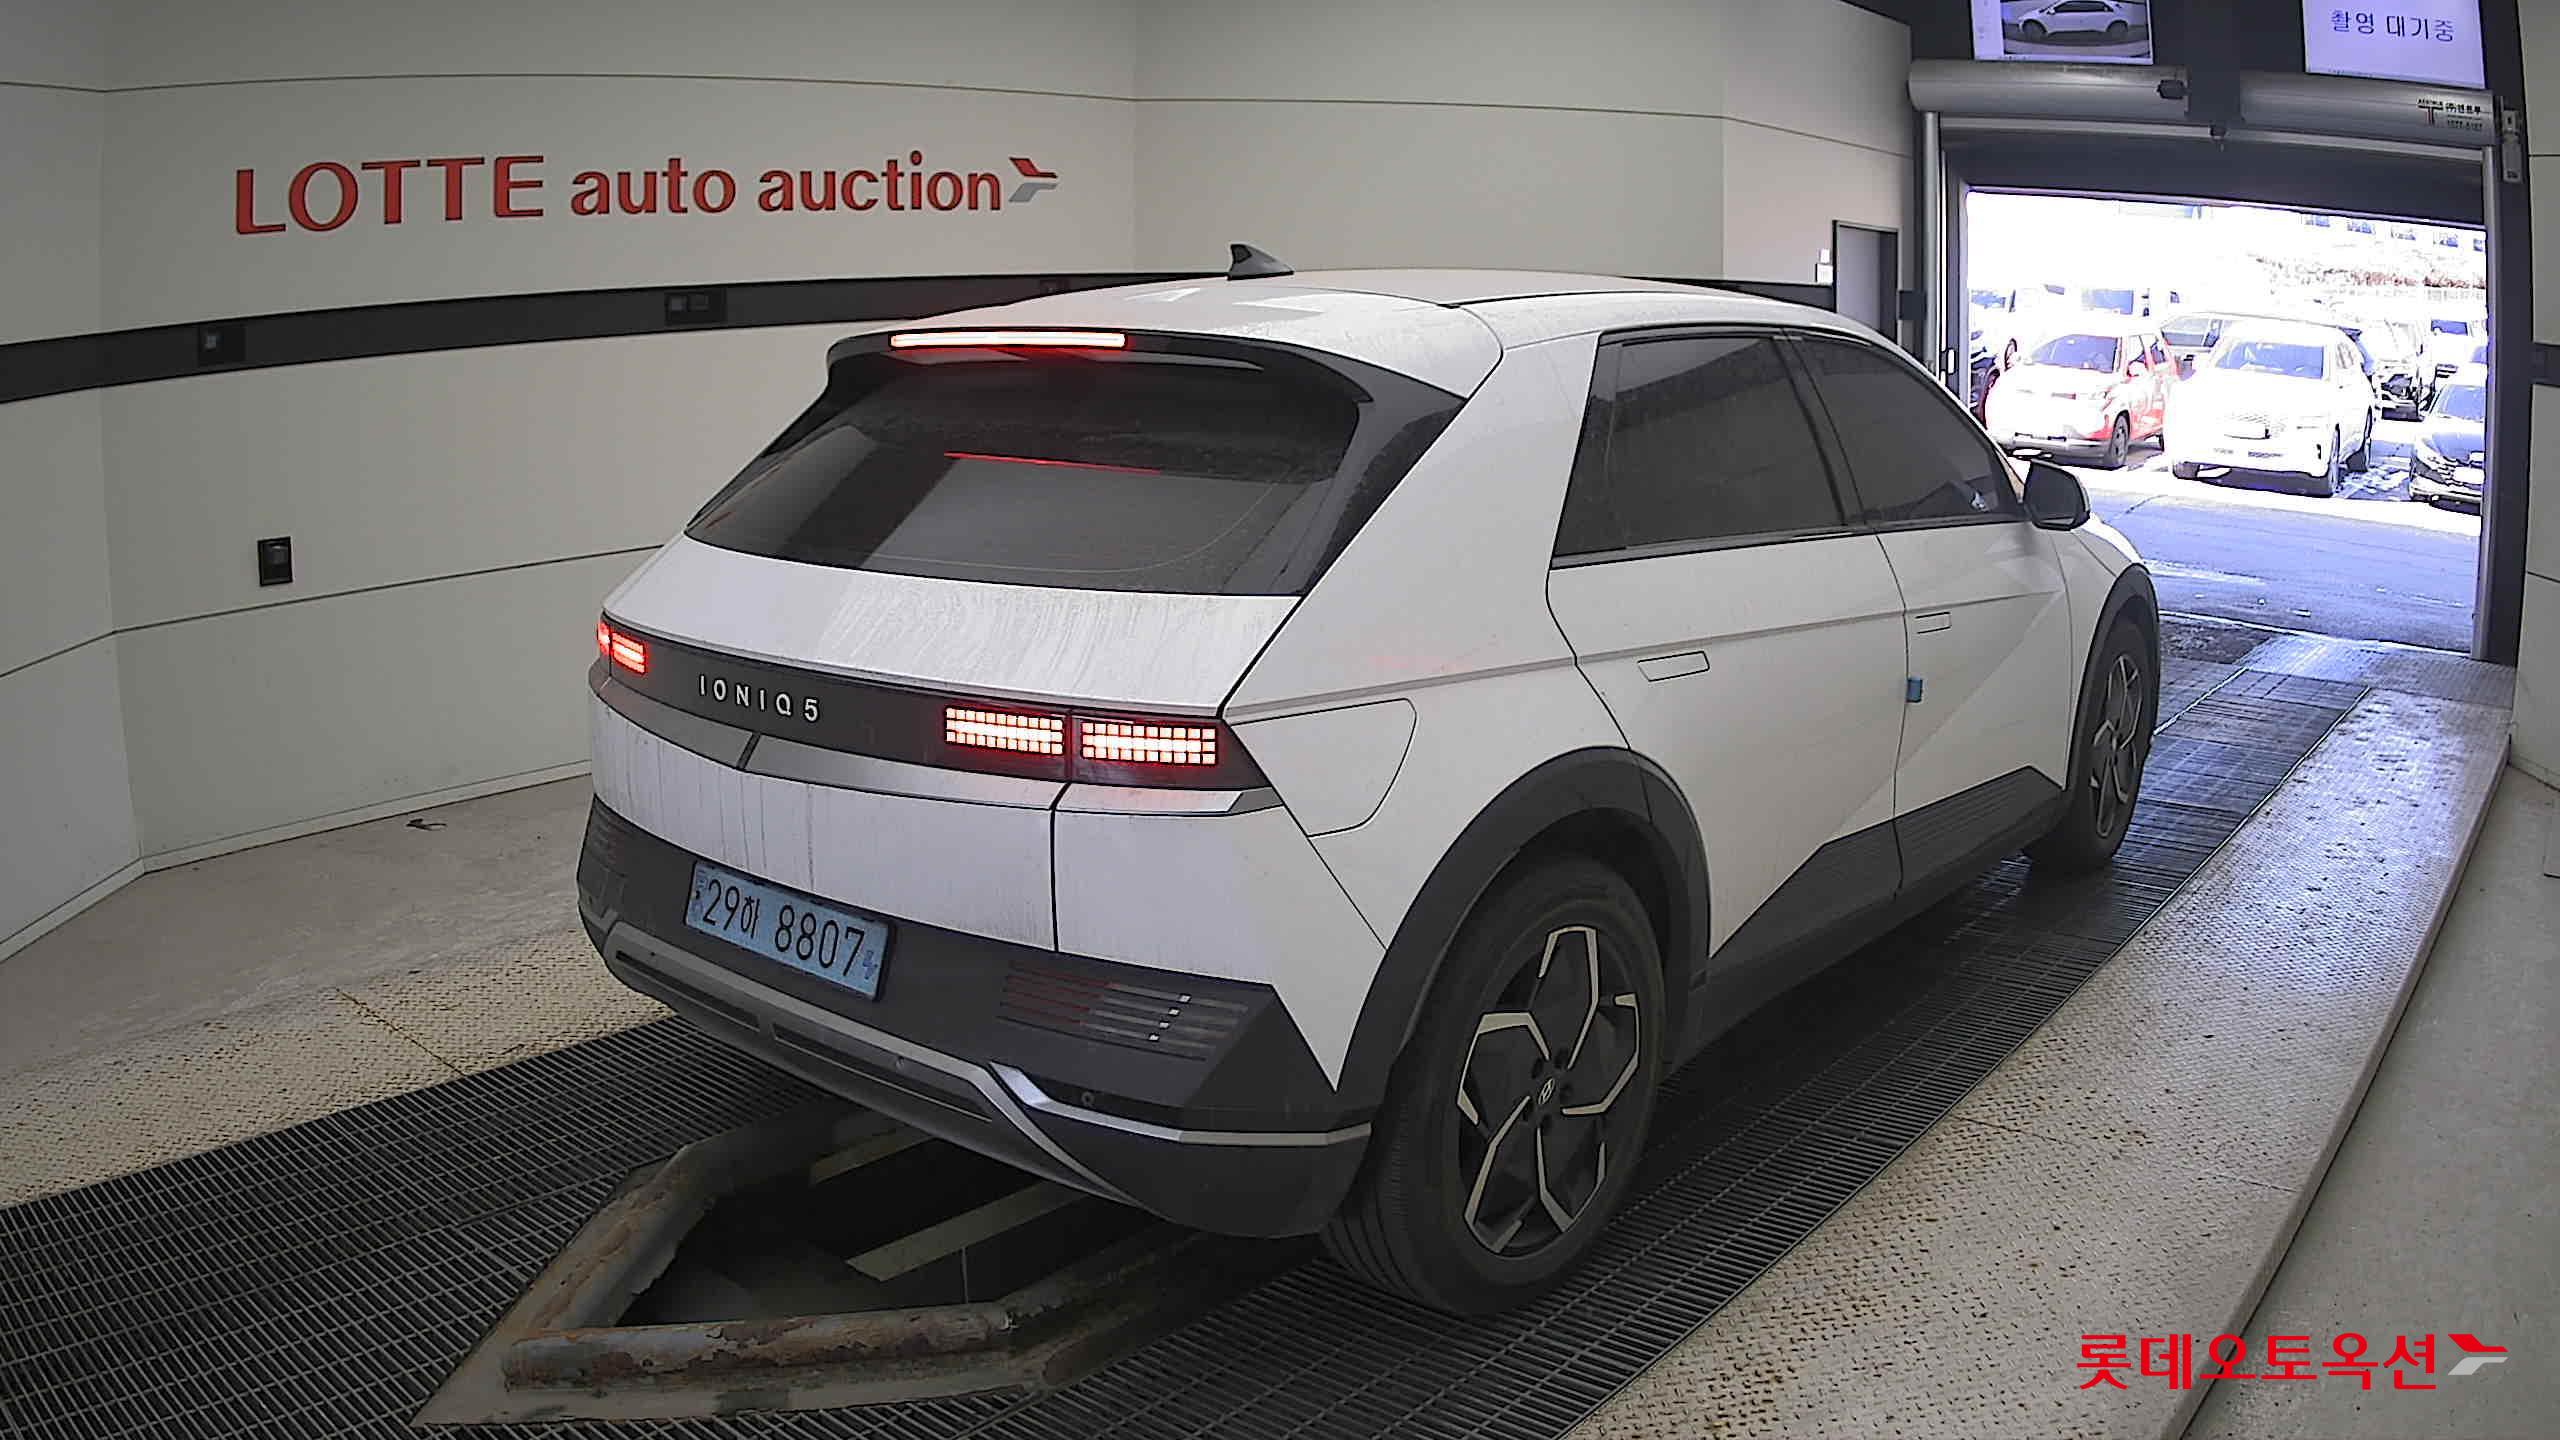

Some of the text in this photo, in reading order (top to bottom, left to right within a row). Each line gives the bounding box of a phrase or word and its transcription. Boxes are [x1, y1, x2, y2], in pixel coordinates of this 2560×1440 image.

[2331, 10, 2455, 42] 촬영 대기중
[235, 150, 1002, 235] LOTTE auto auction
[700, 675, 818, 721] IONIQ 5
[702, 878, 865, 977] 29하 8807
